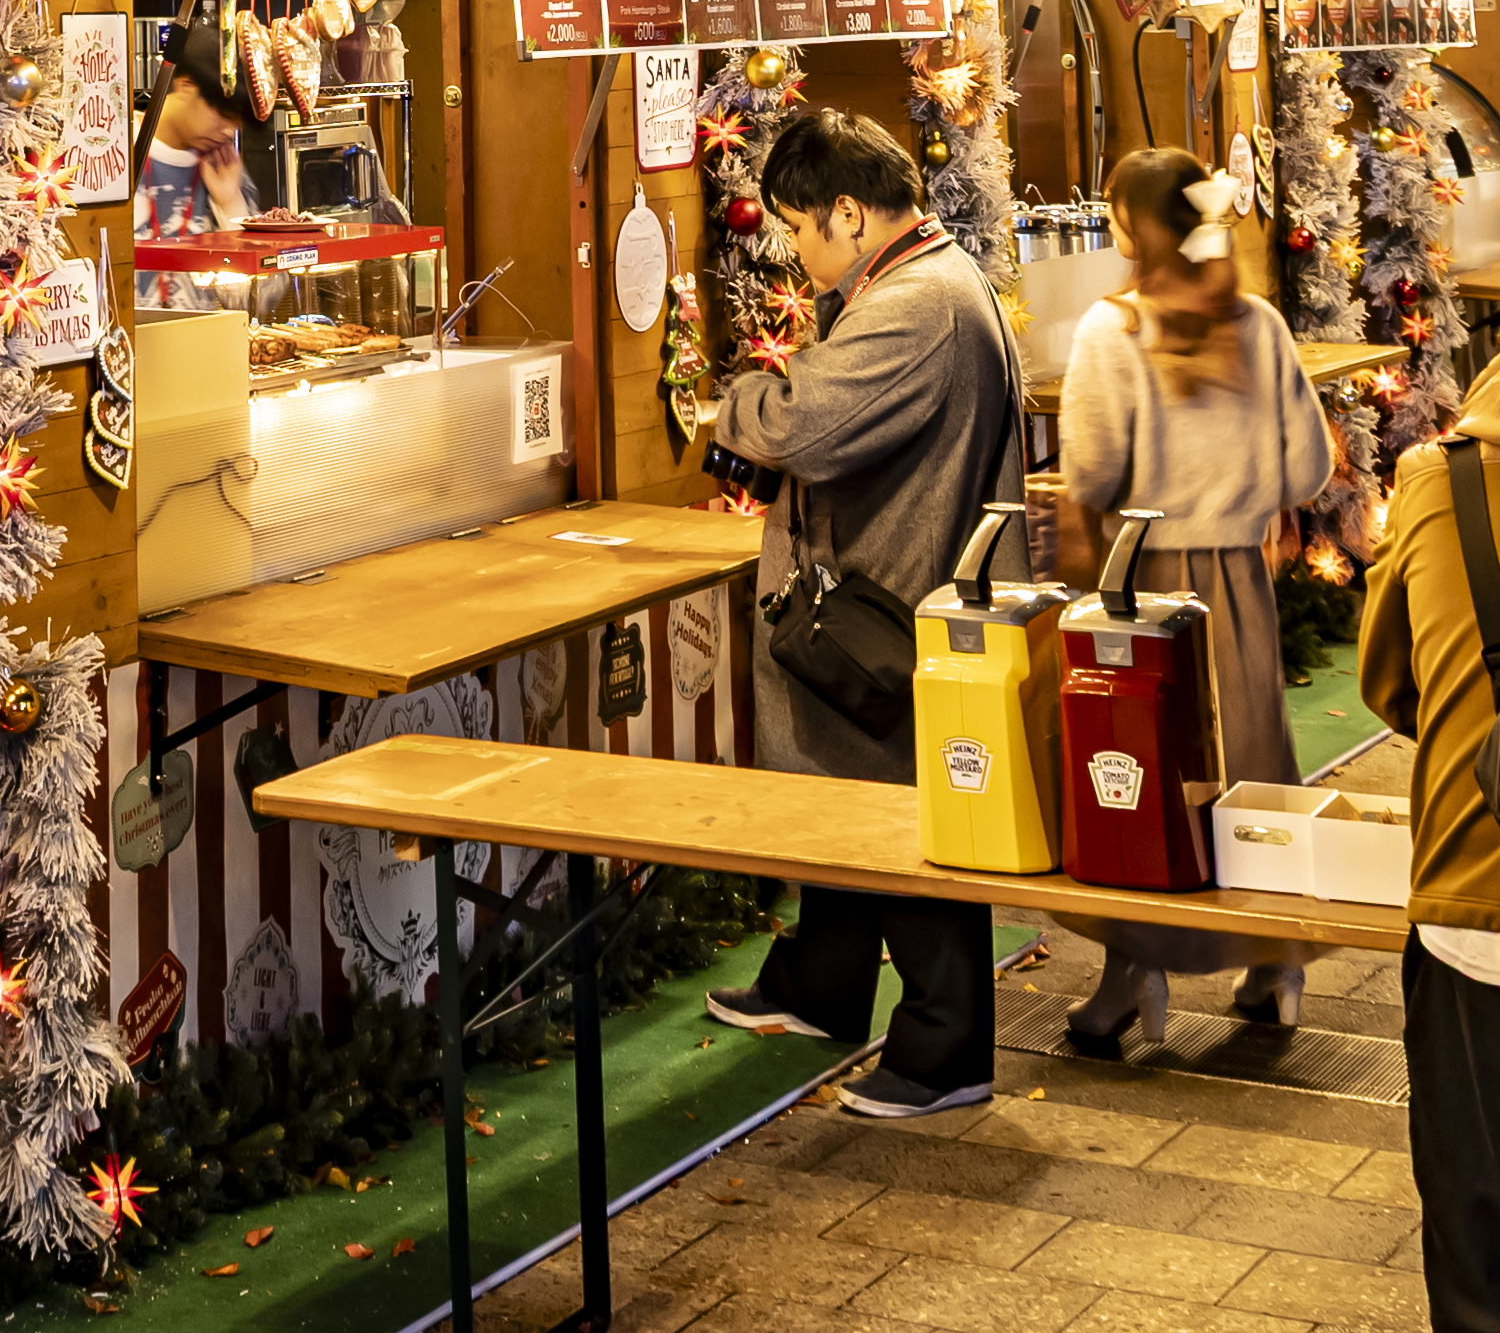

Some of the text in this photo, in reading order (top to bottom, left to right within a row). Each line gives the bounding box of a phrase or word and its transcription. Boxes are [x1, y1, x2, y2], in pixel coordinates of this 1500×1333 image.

[80, 48, 112, 84] HOLLY
[646, 55, 690, 89] SANTA
[78, 95, 116, 133] JOLLY
[653, 118, 685, 144] STOP HERE
[67, 138, 126, 191] CHRISTMAS
[683, 600, 711, 635] Happy
[952, 756, 980, 767] YELLOW
[953, 745, 977, 756] HEINZ
[1103, 759, 1127, 769] HEINZ
[950, 763, 982, 774] MUSTARD
[1102, 770, 1130, 780] TOMATO
[121, 804, 142, 825] Have
[128, 981, 182, 1052] eihnachten
[134, 984, 164, 1024] Frohe
